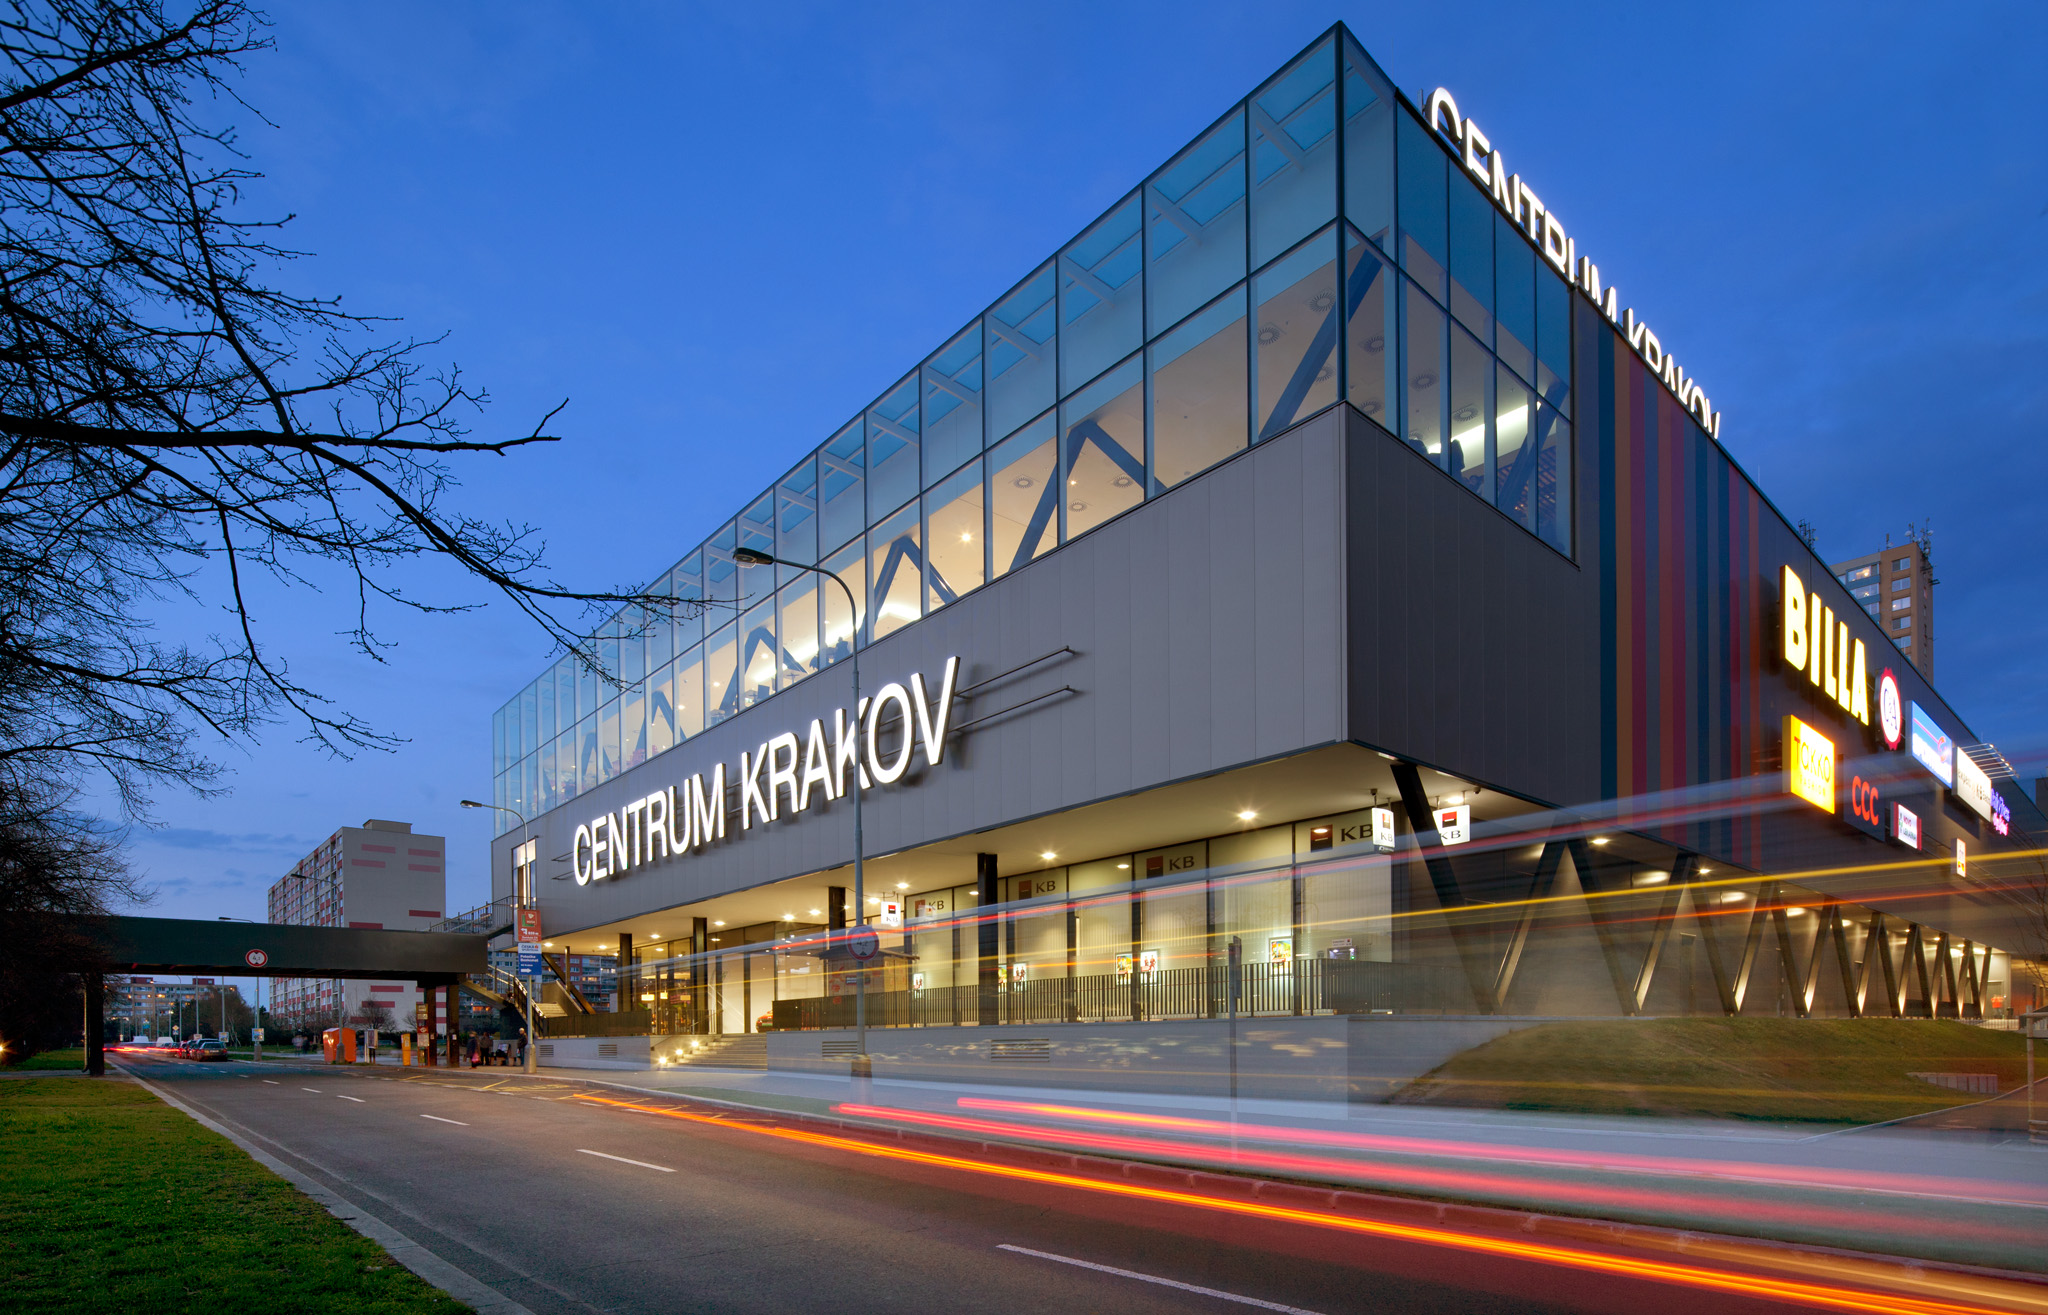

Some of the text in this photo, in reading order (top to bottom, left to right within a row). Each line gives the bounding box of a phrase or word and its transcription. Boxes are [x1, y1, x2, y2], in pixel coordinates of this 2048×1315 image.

[1782, 564, 1869, 726] BILLA
[573, 656, 960, 886] CENTRUM KRAKOV
[1852, 775, 1879, 826] CCC
[1340, 823, 1374, 842] KB
[1380, 831, 1393, 842] KB
[1169, 856, 1195, 871] KB
[1036, 881, 1056, 894] KB
[928, 900, 945, 911] KB
